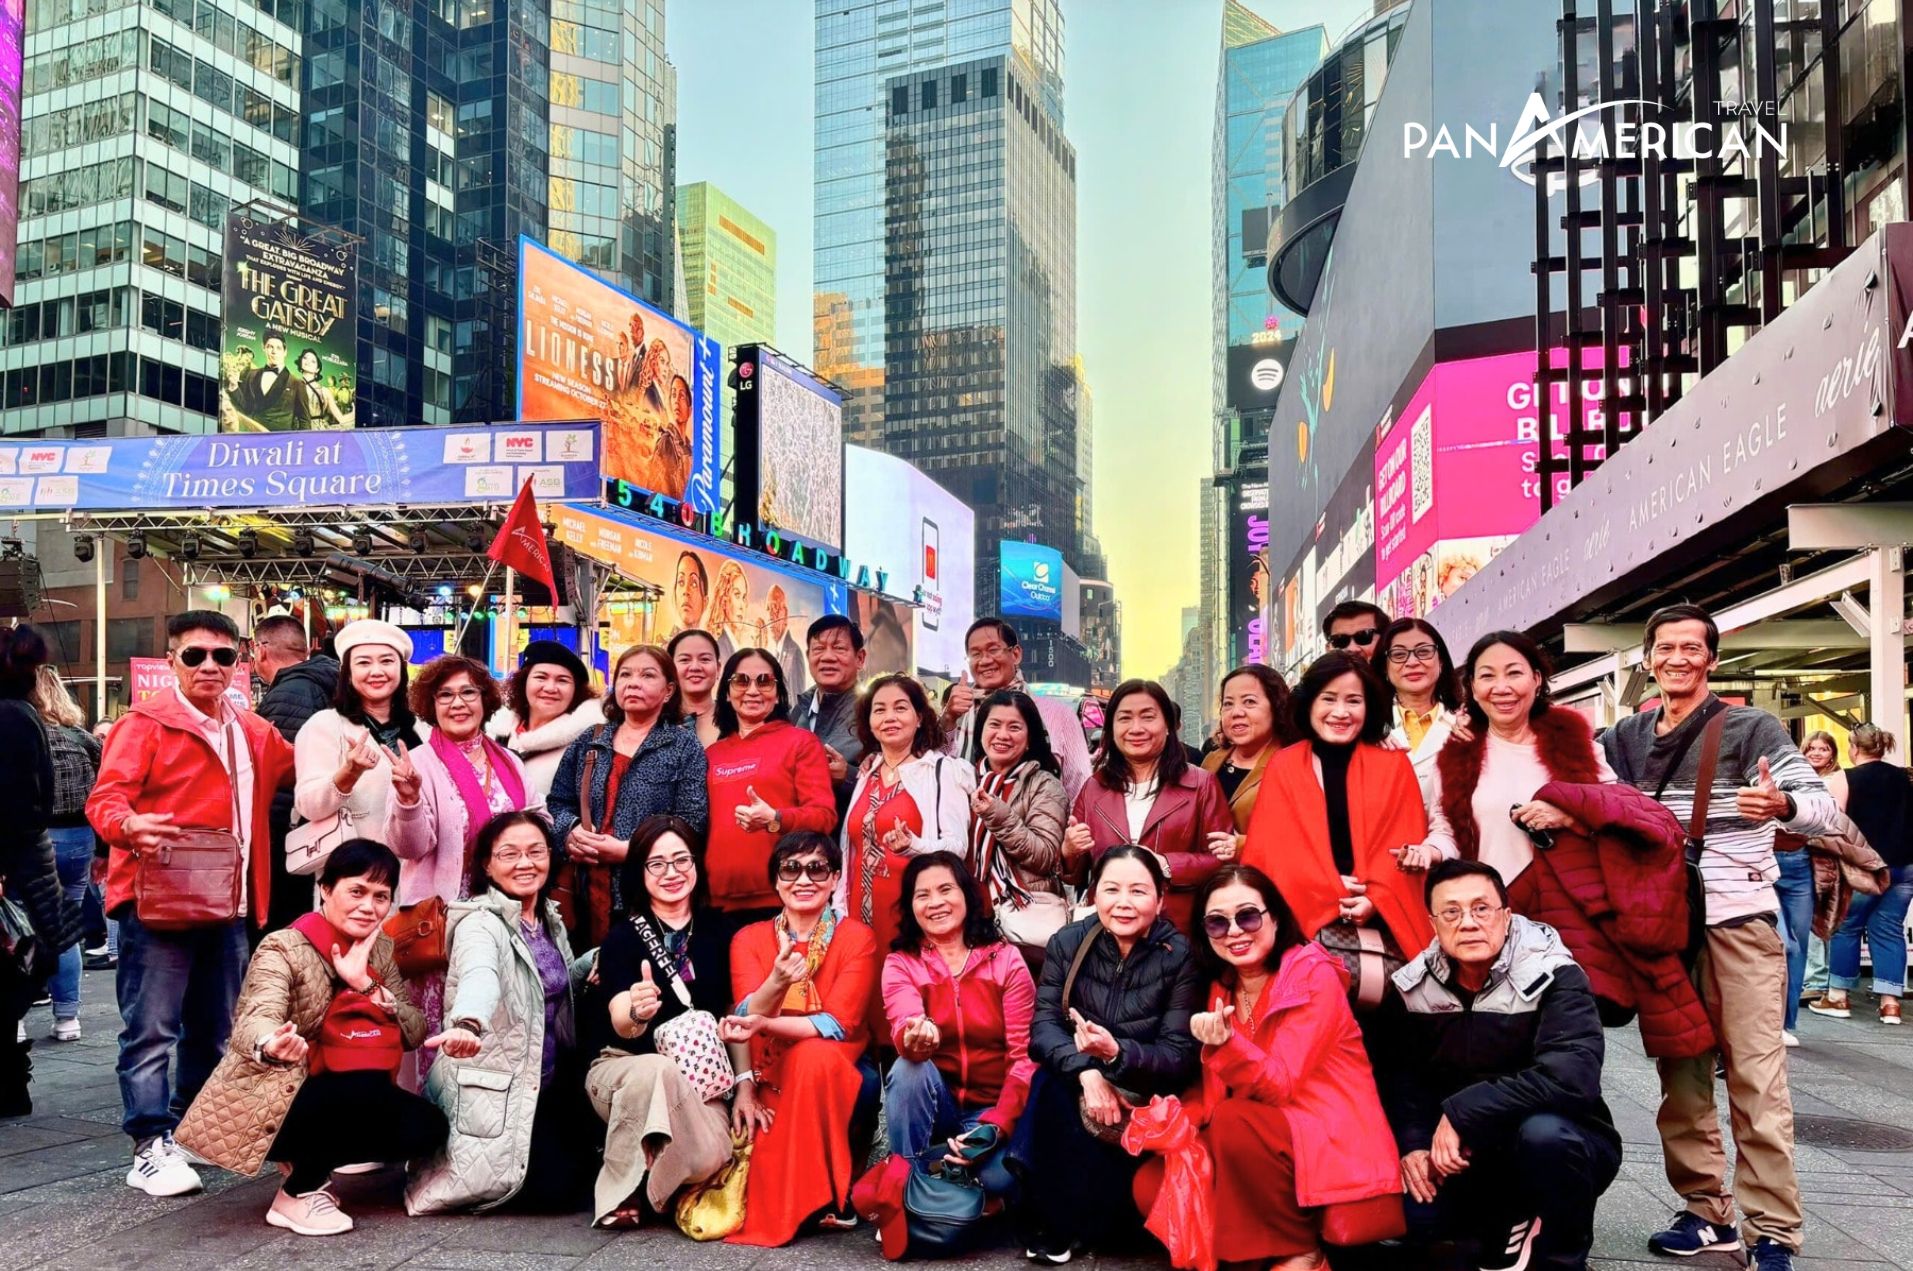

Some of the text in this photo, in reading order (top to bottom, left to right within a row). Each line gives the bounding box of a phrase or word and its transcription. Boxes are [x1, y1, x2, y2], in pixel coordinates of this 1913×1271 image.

[262, 252, 329, 280] EXTRAVAGANZA
[282, 249, 297, 260] BIG
[299, 254, 345, 276] BROADWAY
[241, 266, 348, 320] THE GREAT
[251, 295, 336, 337] GATSBY
[272, 323, 289, 334] NEW
[290, 329, 322, 344] MUSICAL
[1252, 329, 1282, 344] 2024
[526, 319, 614, 392] LIONESS
[1814, 322, 1881, 418] aerie
[740, 380, 753, 391] LG
[30, 452, 56, 461] NYC
[207, 439, 342, 468] Diwali at
[506, 437, 534, 448] NYC
[1628, 455, 1712, 533] AMERICAN
[1723, 402, 1788, 475] EAGLE
[162, 470, 382, 502] Times Square
[617, 479, 695, 528] 540
[511, 525, 552, 574] AMERIC
[709, 511, 890, 593] BROADWAY
[1584, 512, 1611, 561] aerie
[1021, 580, 1038, 590] Clear
[1498, 548, 1571, 612] AMERICAN EAGLE
[715, 763, 756, 778] Supreme
